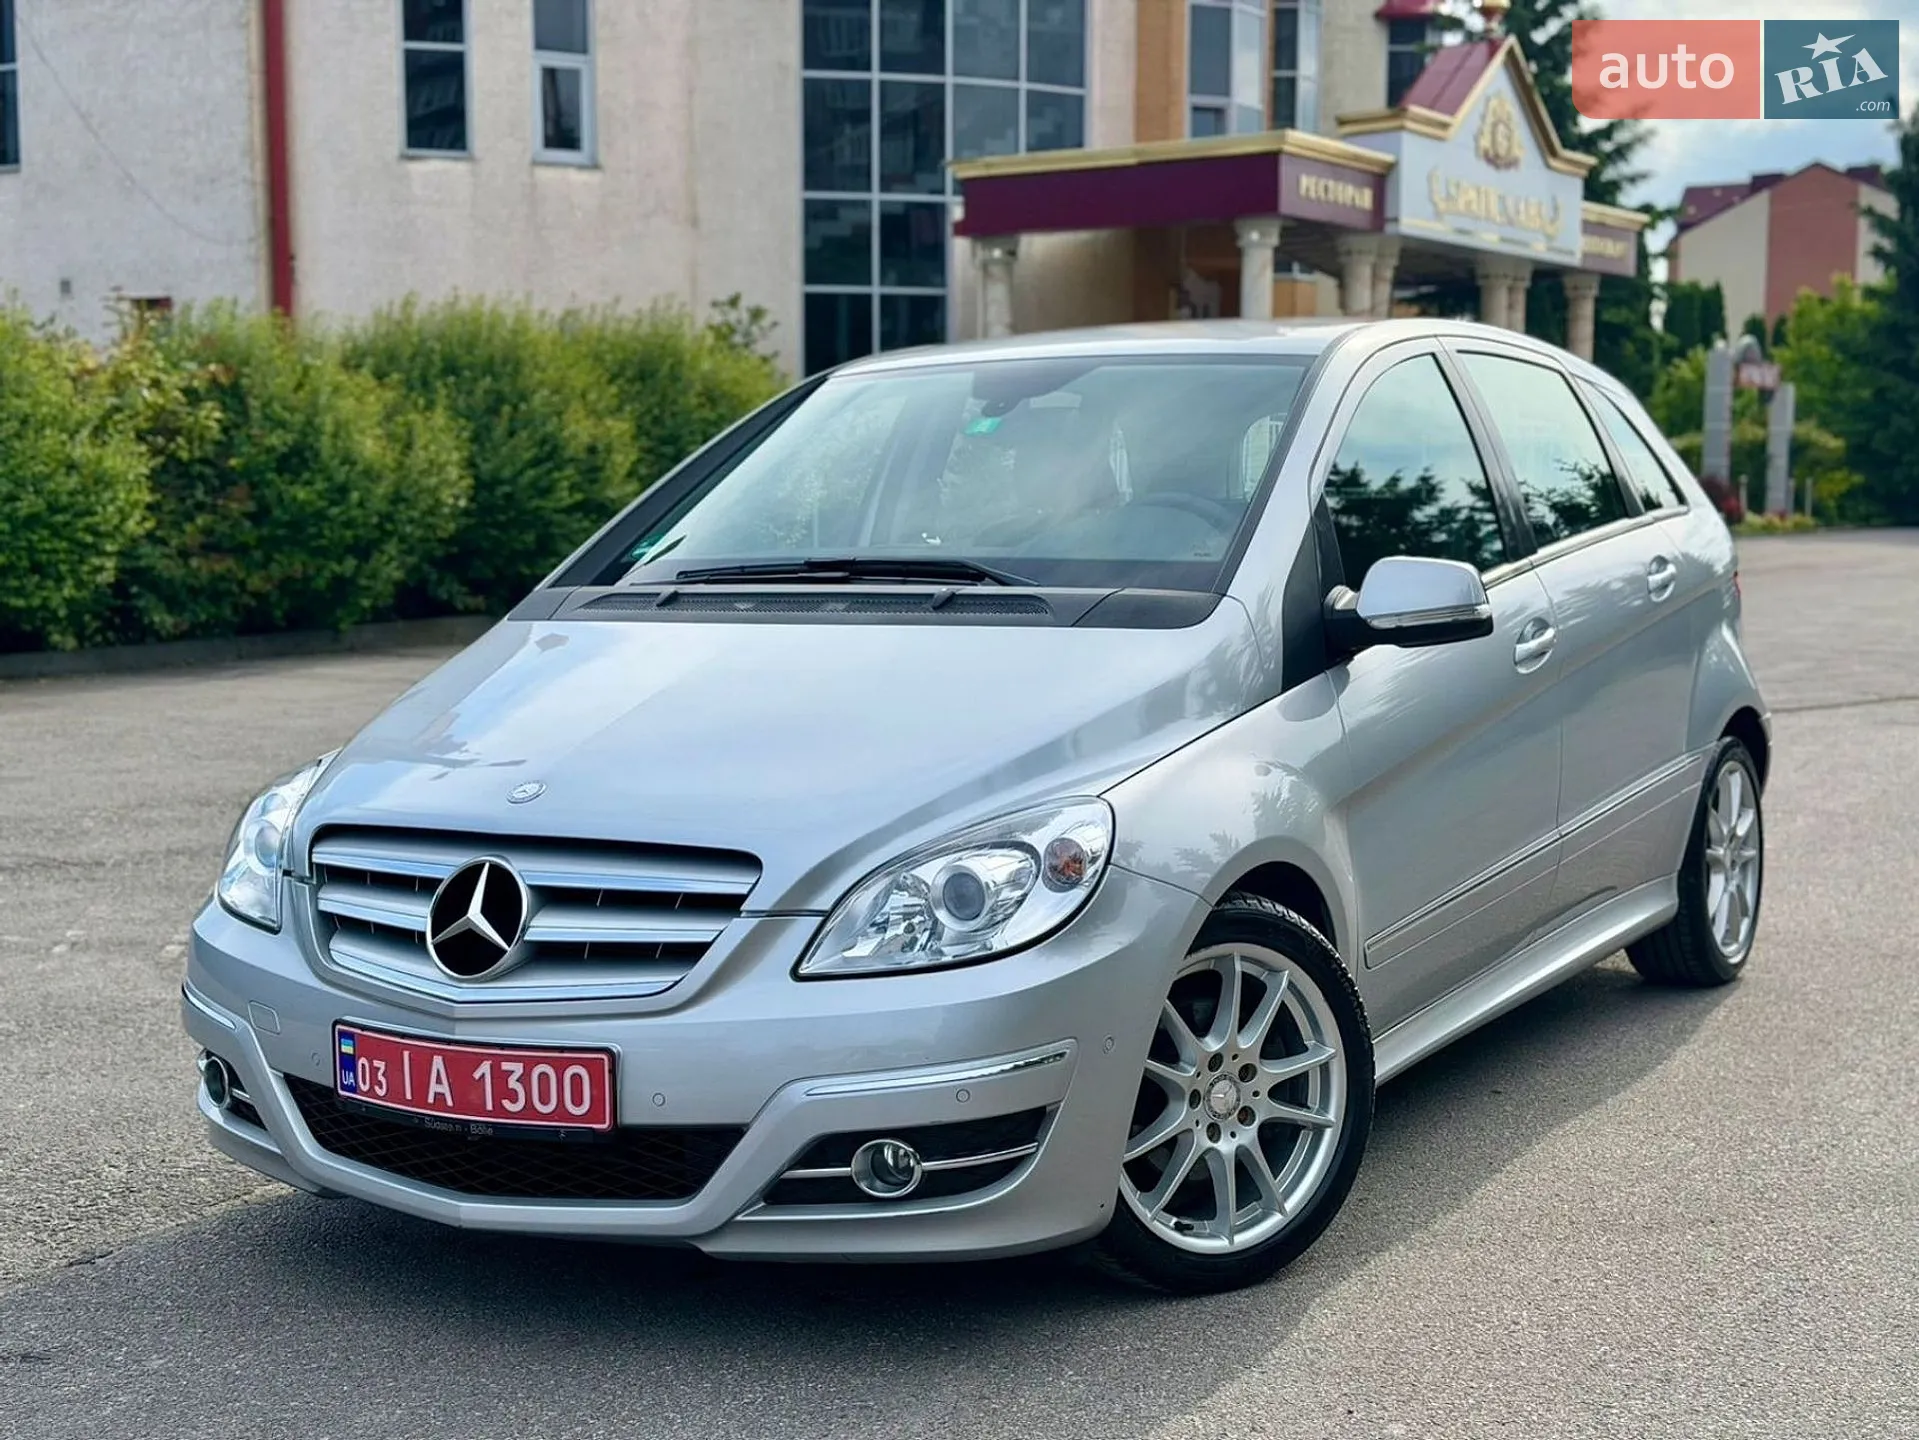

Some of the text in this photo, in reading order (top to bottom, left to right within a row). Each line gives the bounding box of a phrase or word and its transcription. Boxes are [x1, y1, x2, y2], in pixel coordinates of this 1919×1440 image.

[342, 1069, 356, 1087] UA
[358, 1056, 387, 1097] 03
[472, 1059, 591, 1116] 1300
